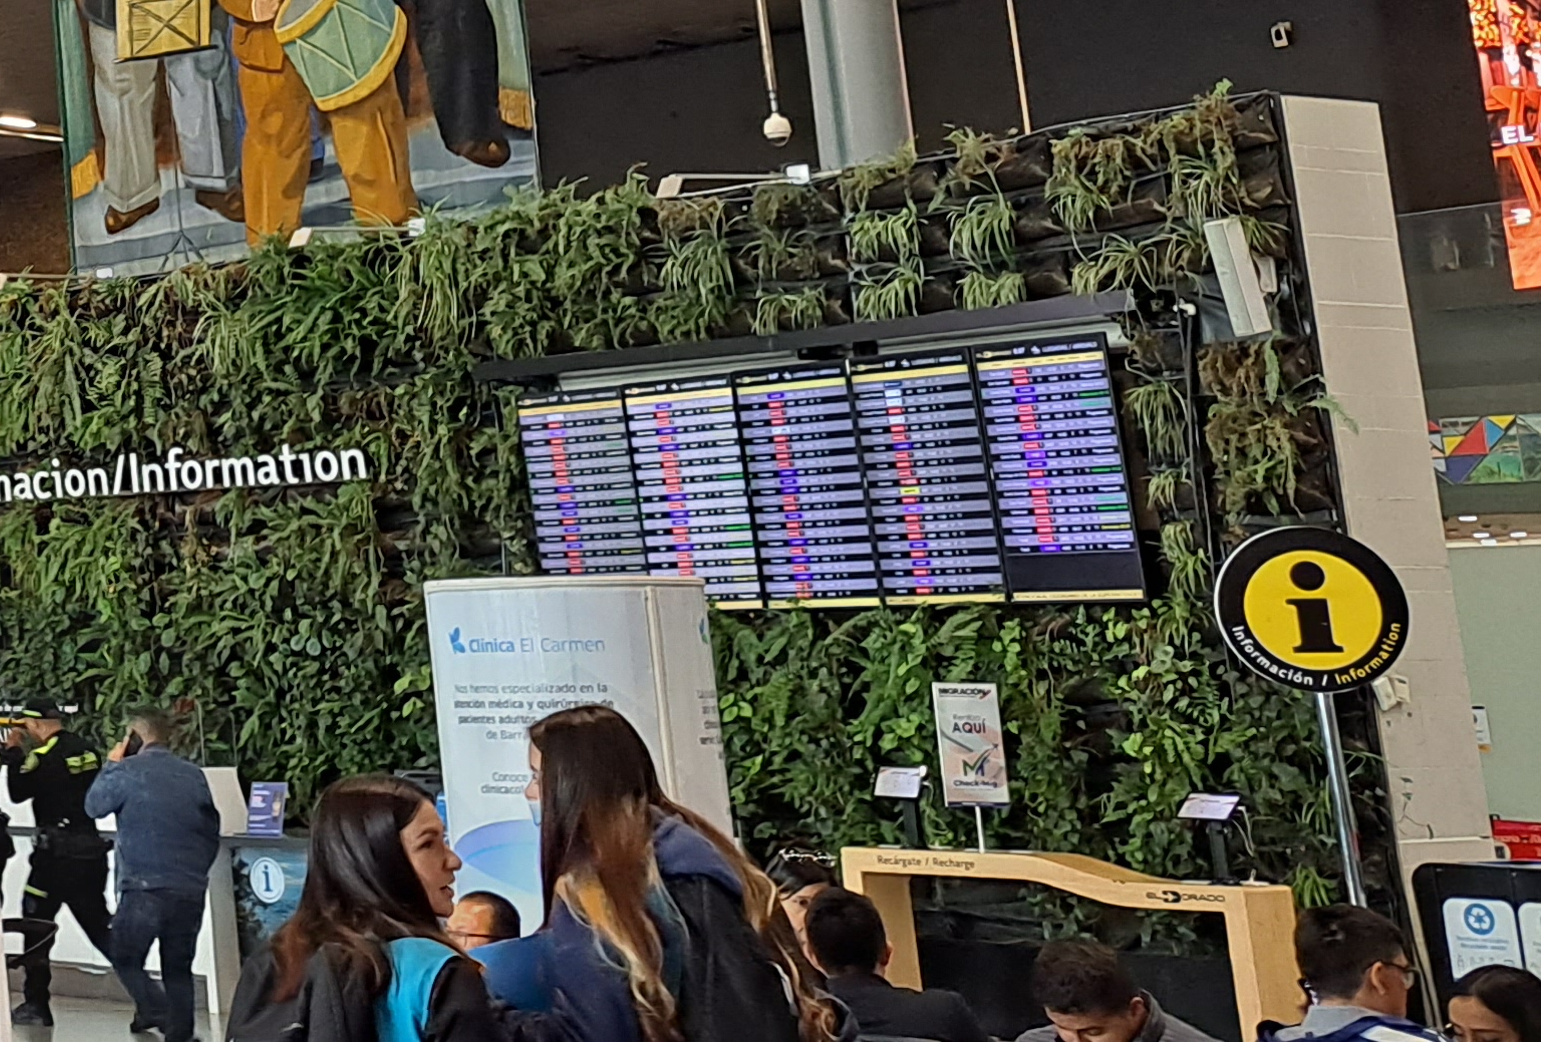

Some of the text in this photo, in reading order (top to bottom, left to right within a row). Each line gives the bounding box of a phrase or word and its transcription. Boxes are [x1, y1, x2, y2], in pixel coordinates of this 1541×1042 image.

[1501, 125, 1535, 145] EL
[468, 637, 606, 653] Clínica El Carmen
[1231, 624, 1314, 686] Información
[1334, 622, 1402, 685] Information
[501, 683, 577, 695] especializado
[580, 684, 594, 693] en
[598, 682, 608, 693] la
[488, 699, 524, 709] médica
[952, 718, 986, 734] AQUÍ
[486, 729, 498, 740] de
[492, 772, 529, 782] Conoce
